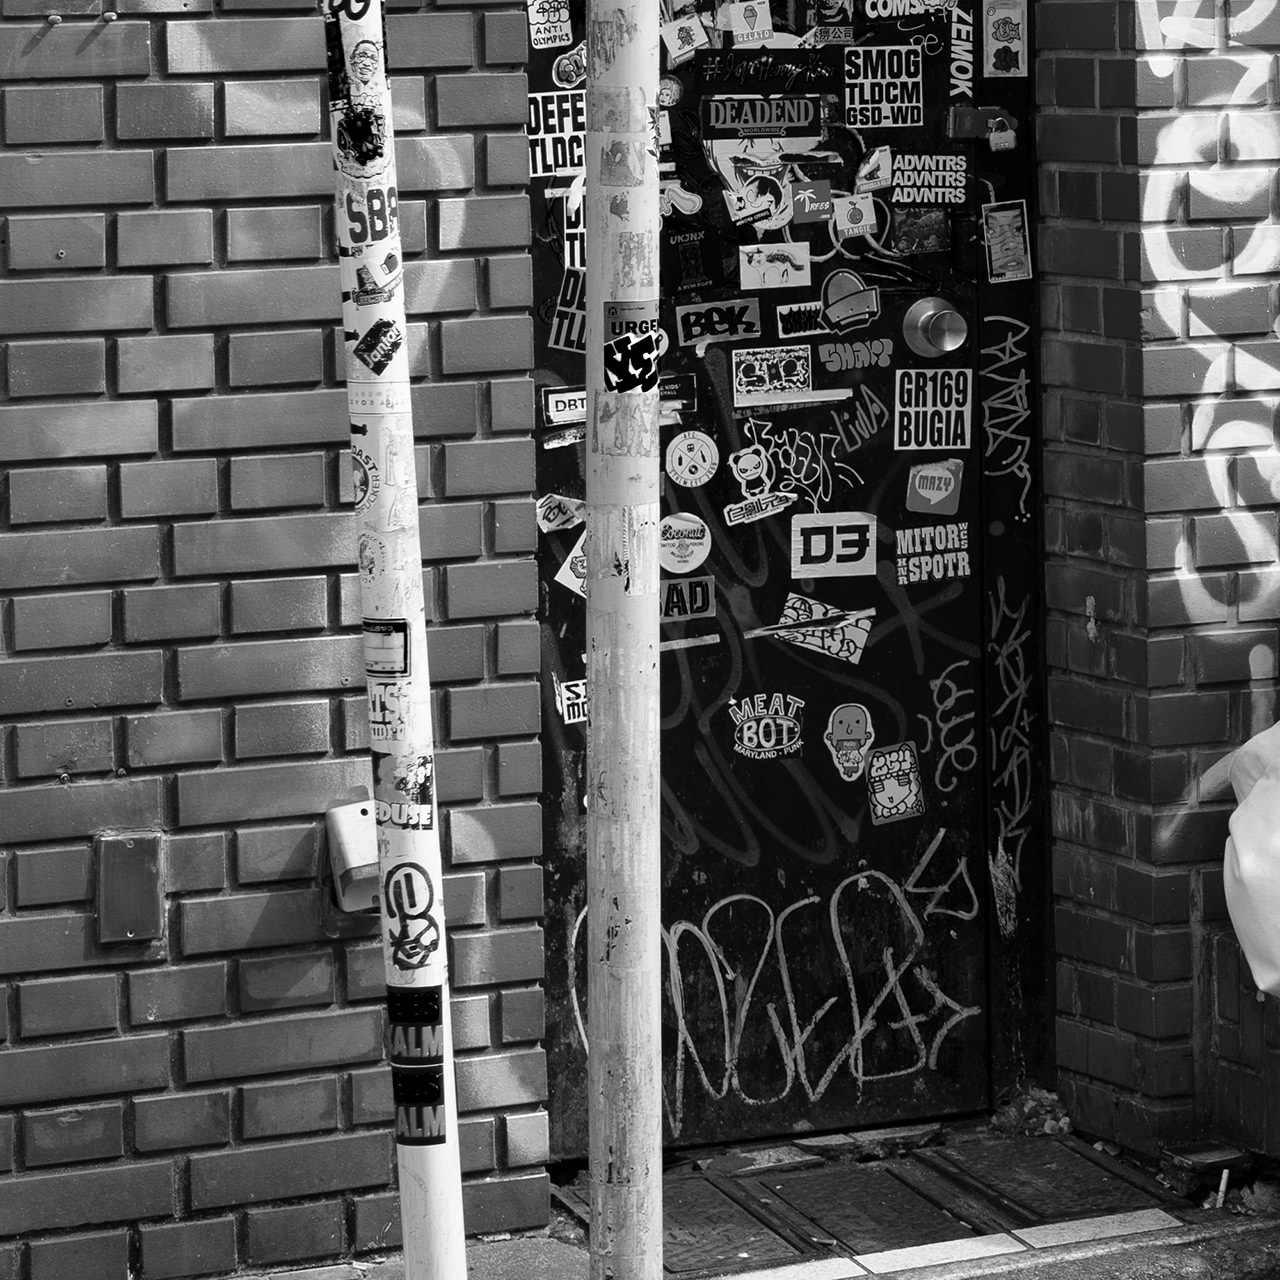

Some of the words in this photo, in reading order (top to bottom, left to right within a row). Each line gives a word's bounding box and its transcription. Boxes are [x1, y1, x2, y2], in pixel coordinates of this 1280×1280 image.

[532, 33, 571, 46] OLYMPICS
[535, 24, 564, 36] ANTI
[737, 30, 770, 43] GELATO
[845, 49, 921, 80] SMOG
[845, 81, 921, 106] TLDCM
[709, 99, 815, 126] DEADEND
[846, 106, 922, 126] GSD-WD
[743, 126, 780, 134] WORLDWIDE
[893, 154, 967, 171] ADVNTRS
[892, 170, 967, 187] ADVNTRS
[891, 187, 966, 204] ADVNTRS
[843, 225, 872, 237] TANGIE
[899, 370, 969, 409] GR169
[898, 409, 968, 448] BUGIA
[917, 474, 953, 492] MAZY
[661, 524, 706, 541] Coconut
[895, 523, 960, 557] MITOR
[907, 550, 972, 585] SPOTR
[728, 692, 805, 726] MEAT
[743, 717, 797, 748] BOT
[733, 743, 777, 760] MARYLAND
[784, 738, 805, 756] PUNK
